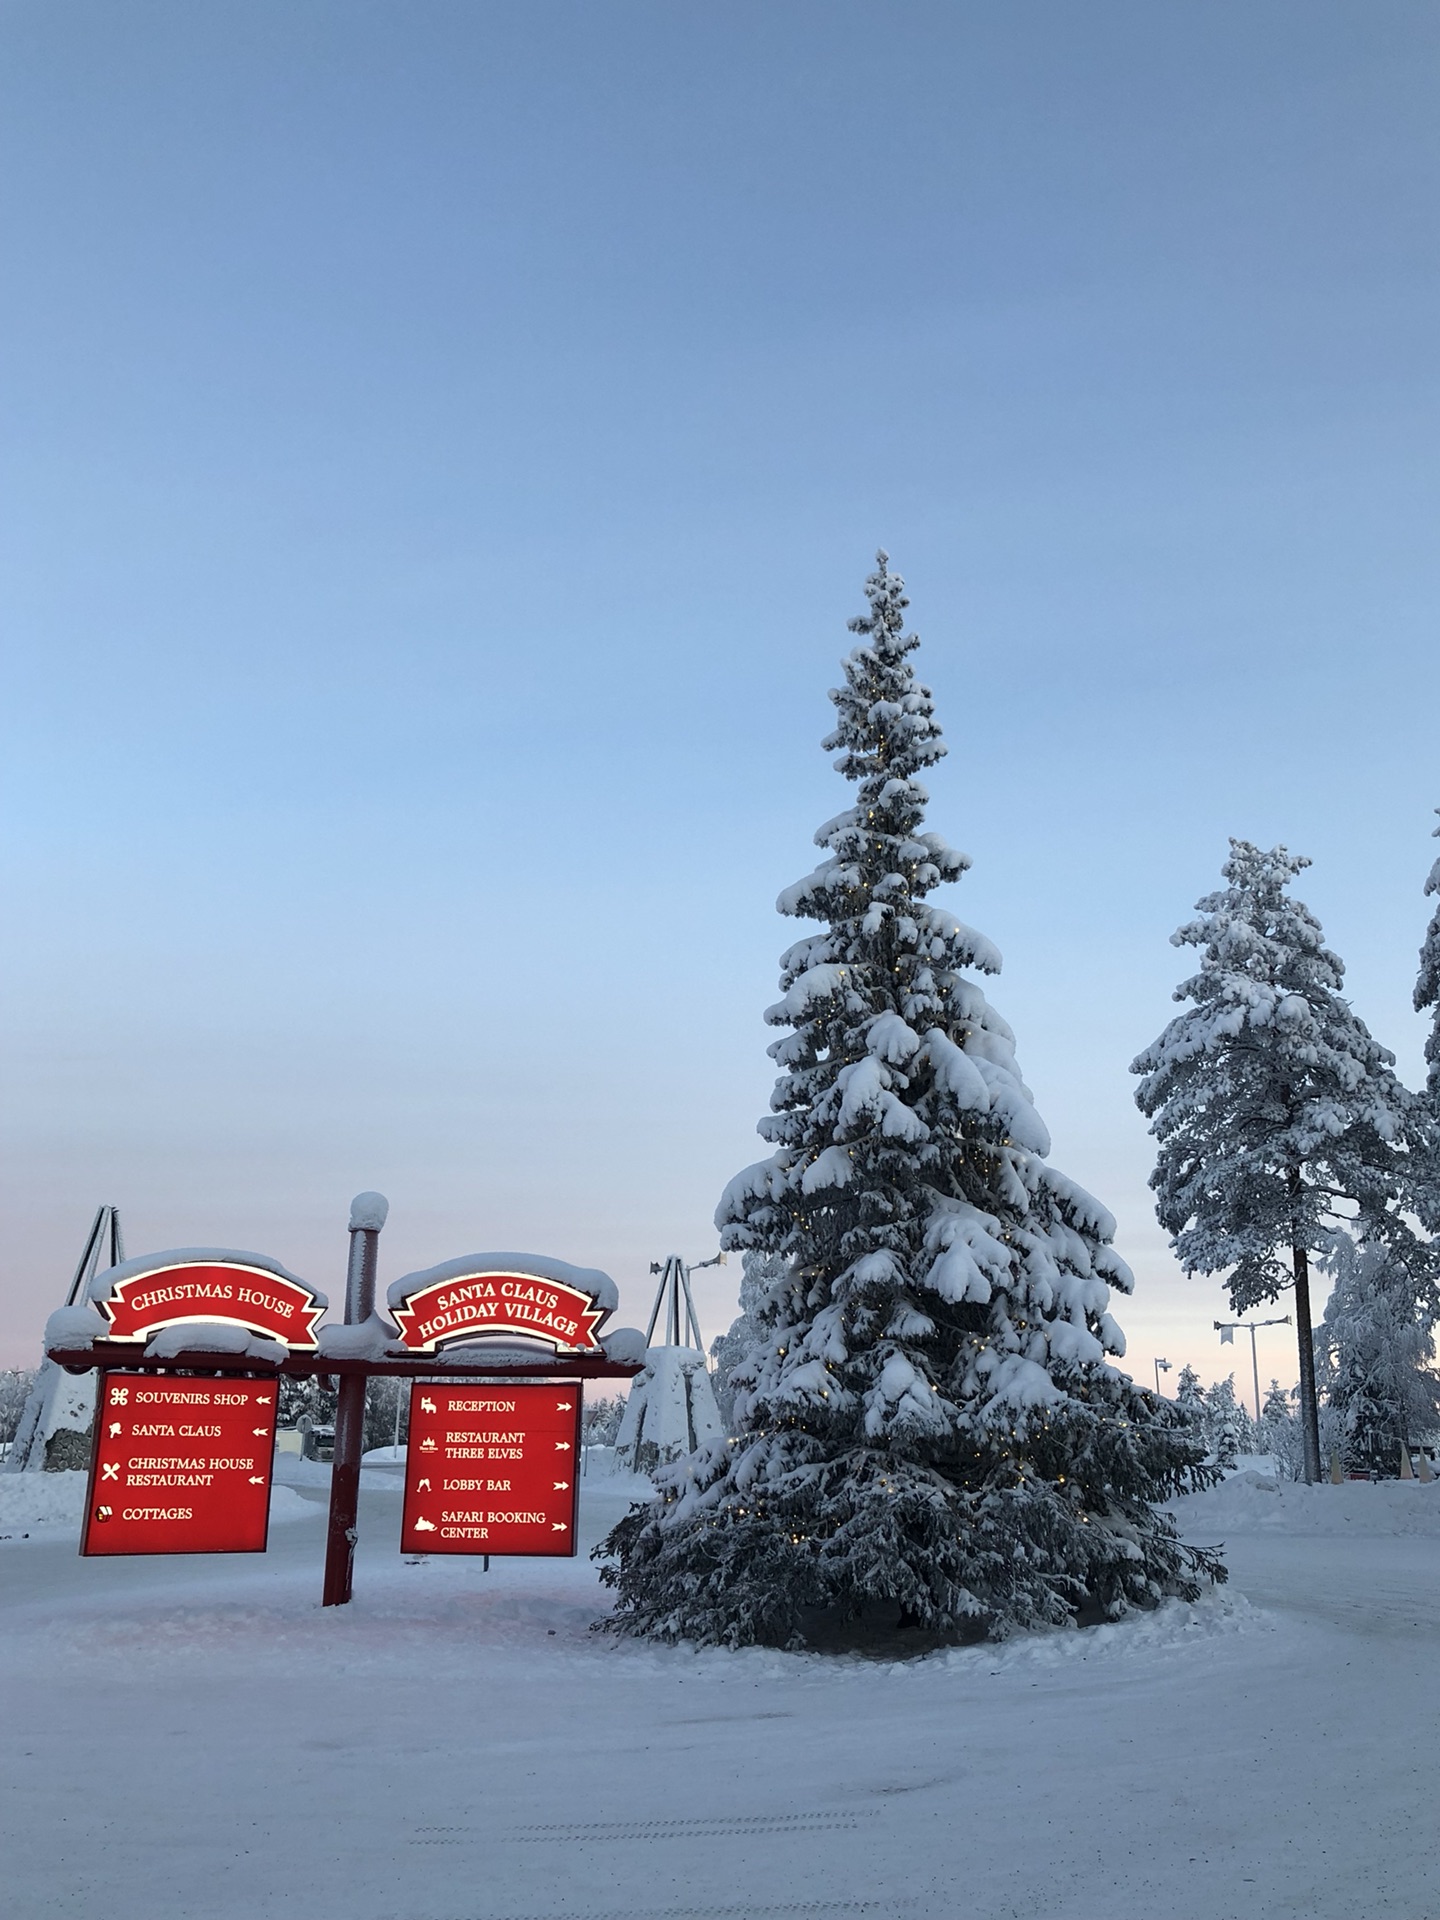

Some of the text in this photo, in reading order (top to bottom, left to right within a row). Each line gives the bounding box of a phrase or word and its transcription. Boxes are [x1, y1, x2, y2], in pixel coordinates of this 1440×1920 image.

[131, 1284, 294, 1318] CHRISTMAS HOUSE
[437, 1282, 559, 1311] SANTA CLAUS
[418, 1302, 579, 1339] HOLIDAY VILLAGE
[135, 1391, 249, 1406] SOUVENIRS SHOP
[447, 1400, 516, 1412] RECEPTION
[131, 1424, 222, 1437] SANTA CLAUS
[445, 1431, 526, 1444] RESTAURANT
[444, 1447, 485, 1459] THREE
[487, 1447, 524, 1460] ELVES
[127, 1457, 254, 1470] CHRISTMAS HOUSE
[125, 1474, 214, 1487] RESTAURANT
[442, 1478, 512, 1491] LOBBY BAR
[122, 1507, 193, 1521] COTTAGES
[441, 1510, 547, 1524] SAFARI BOOKING
[440, 1526, 489, 1539] CENTER
